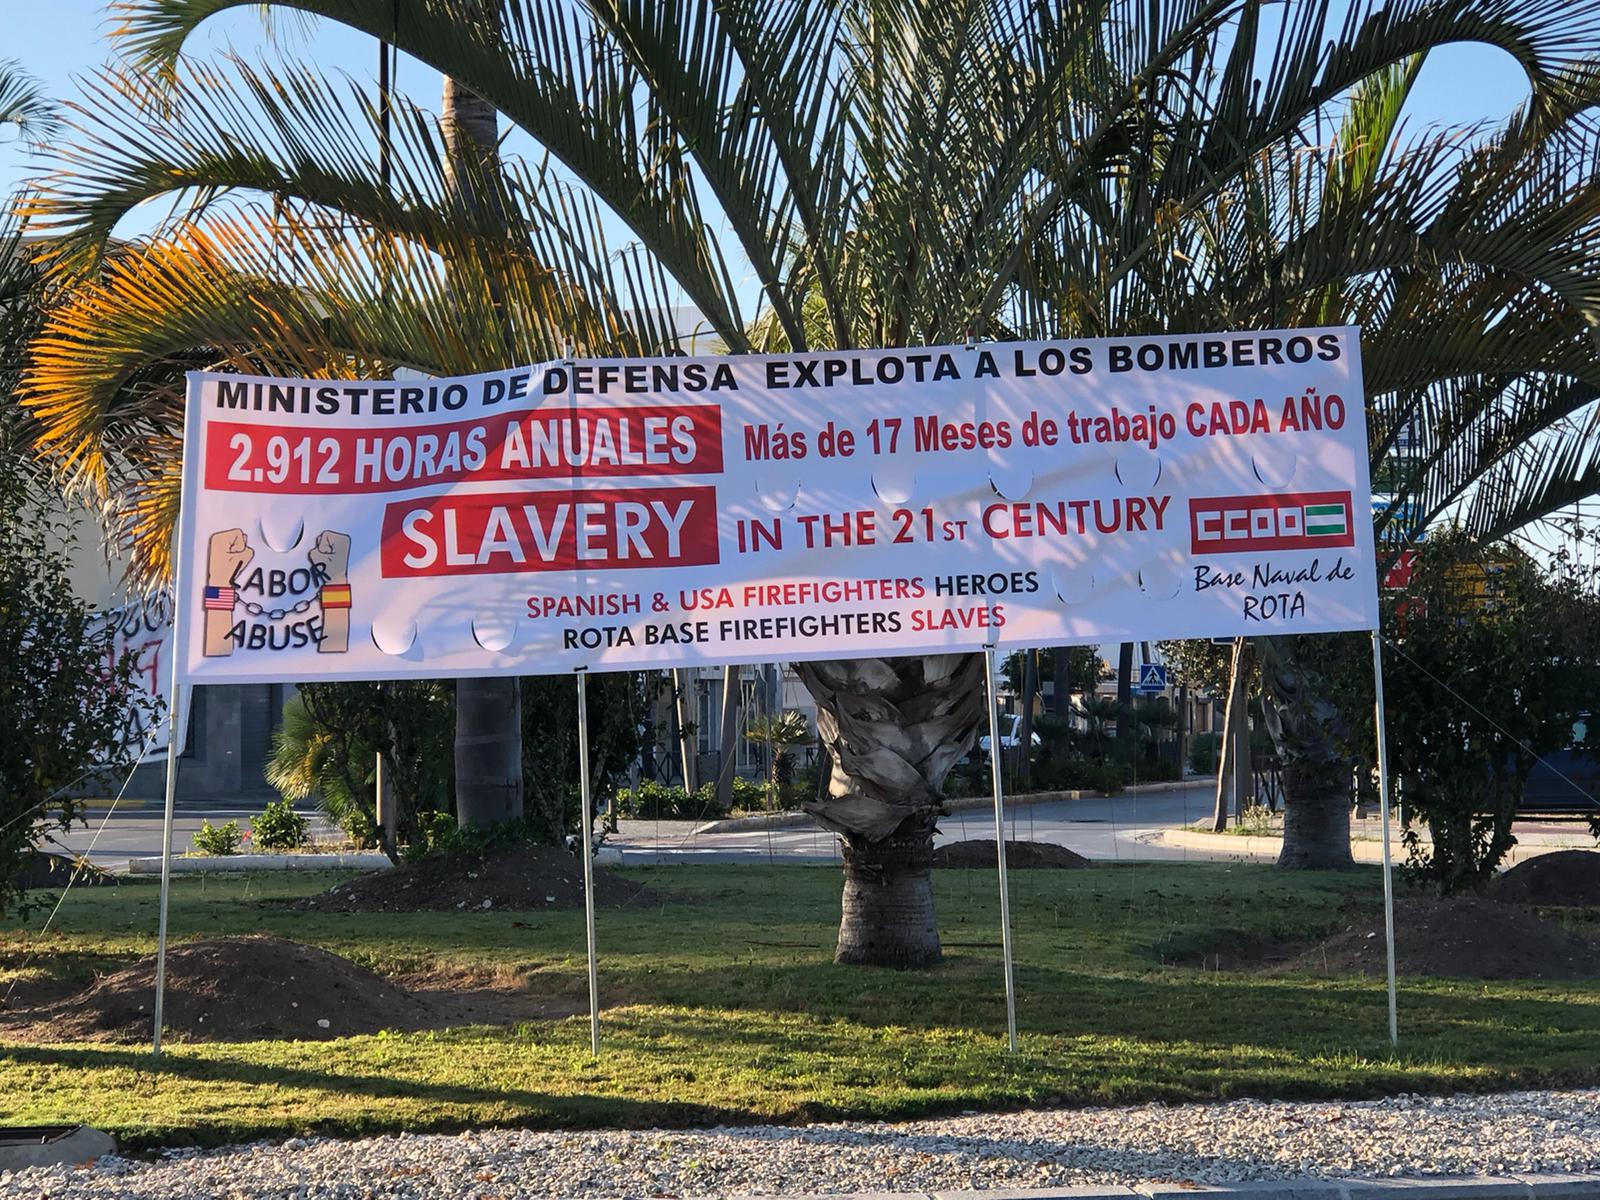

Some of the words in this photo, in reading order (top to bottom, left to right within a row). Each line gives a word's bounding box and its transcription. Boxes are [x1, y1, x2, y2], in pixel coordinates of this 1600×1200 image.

[217, 380, 467, 415] MINISTERIO
[482, 374, 530, 404] DE
[543, 363, 739, 395] DEFENSA
[766, 354, 961, 390] EXPLOTA
[973, 350, 1000, 378] A
[1014, 346, 1093, 377] LOS
[1109, 334, 1341, 372] BOMBEROS
[744, 422, 808, 461] Más
[818, 421, 855, 458] de
[866, 417, 903, 455] 17
[914, 411, 1012, 452] Meses
[1021, 410, 1059, 445] de
[1068, 403, 1177, 450] trabajo
[1186, 399, 1271, 437] CADA
[1279, 387, 1346, 431] AÑO
[227, 432, 341, 485] 2.912
[354, 426, 487, 484] HORAS
[501, 414, 698, 470] ANUALES
[402, 500, 696, 569] SLAVERY
[738, 518, 782, 553] IN
[797, 511, 875, 549] THE
[982, 495, 1172, 540] CENTURY
[1196, 509, 1302, 540] CCOO
[229, 561, 332, 598] LABOR
[527, 592, 642, 619] SPANISH
[651, 591, 670, 612] &
[680, 588, 735, 610] USA
[743, 576, 926, 607] FIREFIGHTERS
[935, 571, 1039, 597] HEROES
[1195, 565, 1246, 591] Base
[1251, 559, 1321, 590] Naval
[1326, 557, 1356, 582] de
[563, 624, 635, 649] ROTA
[645, 618, 711, 645] BASE
[719, 611, 902, 642] FIREFIGHTERS
[911, 606, 1006, 631] SLAVES
[1244, 592, 1306, 622] ROTA
[223, 615, 329, 651] ABUSE
